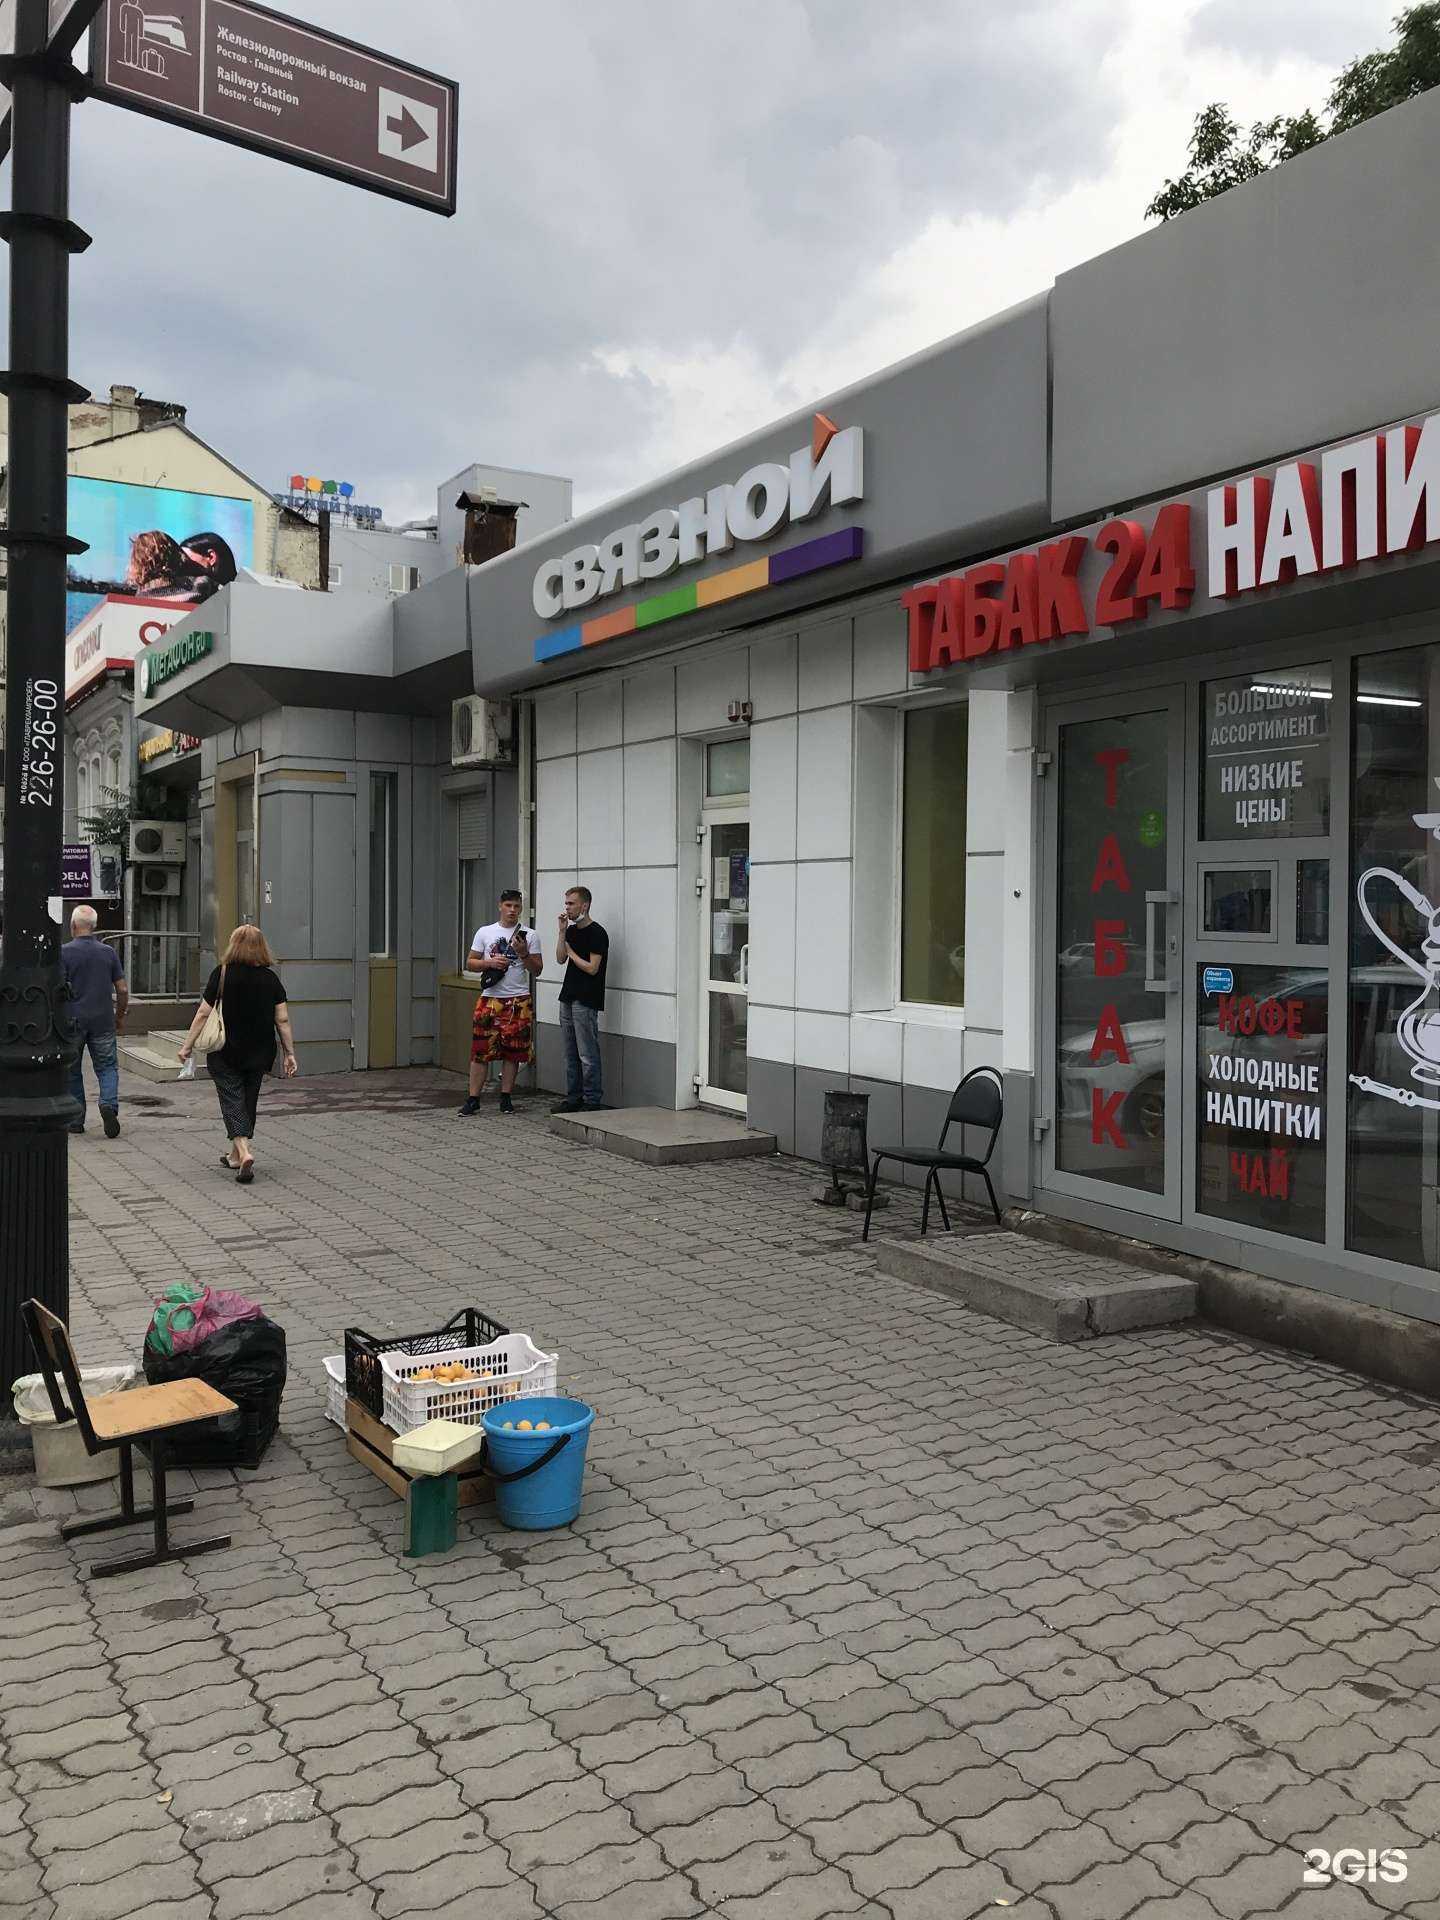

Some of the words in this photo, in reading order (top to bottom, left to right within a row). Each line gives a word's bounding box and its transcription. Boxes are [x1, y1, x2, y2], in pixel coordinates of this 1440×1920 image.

[216, 44, 247, 64] Ростов
[255, 58, 293, 81] Главный
[217, 25, 327, 78] Железнодорожный
[329, 70, 366, 92] вокзал
[217, 65, 259, 94] Railway
[261, 82, 299, 105] Station
[218, 84, 247, 102] Rostov
[254, 97, 282, 116] Glavny
[533, 413, 864, 620] СВЯЗНОЙ
[901, 536, 1090, 673] ТАБАК
[1094, 504, 1195, 627] 24
[1208, 411, 1440, 600] НАПИ
[1215, 674, 1312, 717] БОЛЬШОЙ
[28, 679, 58, 807] 226-26-00
[1210, 714, 1316, 746] АССОРТИМЕНТ
[1221, 760, 1303, 793] НИЗКИЕ
[1235, 798, 1286, 828] ЦЕНЫ
[1090, 747, 1132, 1151] ТАБАК
[1217, 993, 1304, 1041] КОФЕ
[1208, 1054, 1319, 1093] ХОЛОДНЫЕ
[1206, 1091, 1321, 1141] НАПИТКИ
[1231, 1148, 1291, 1201] ЧАЙ
